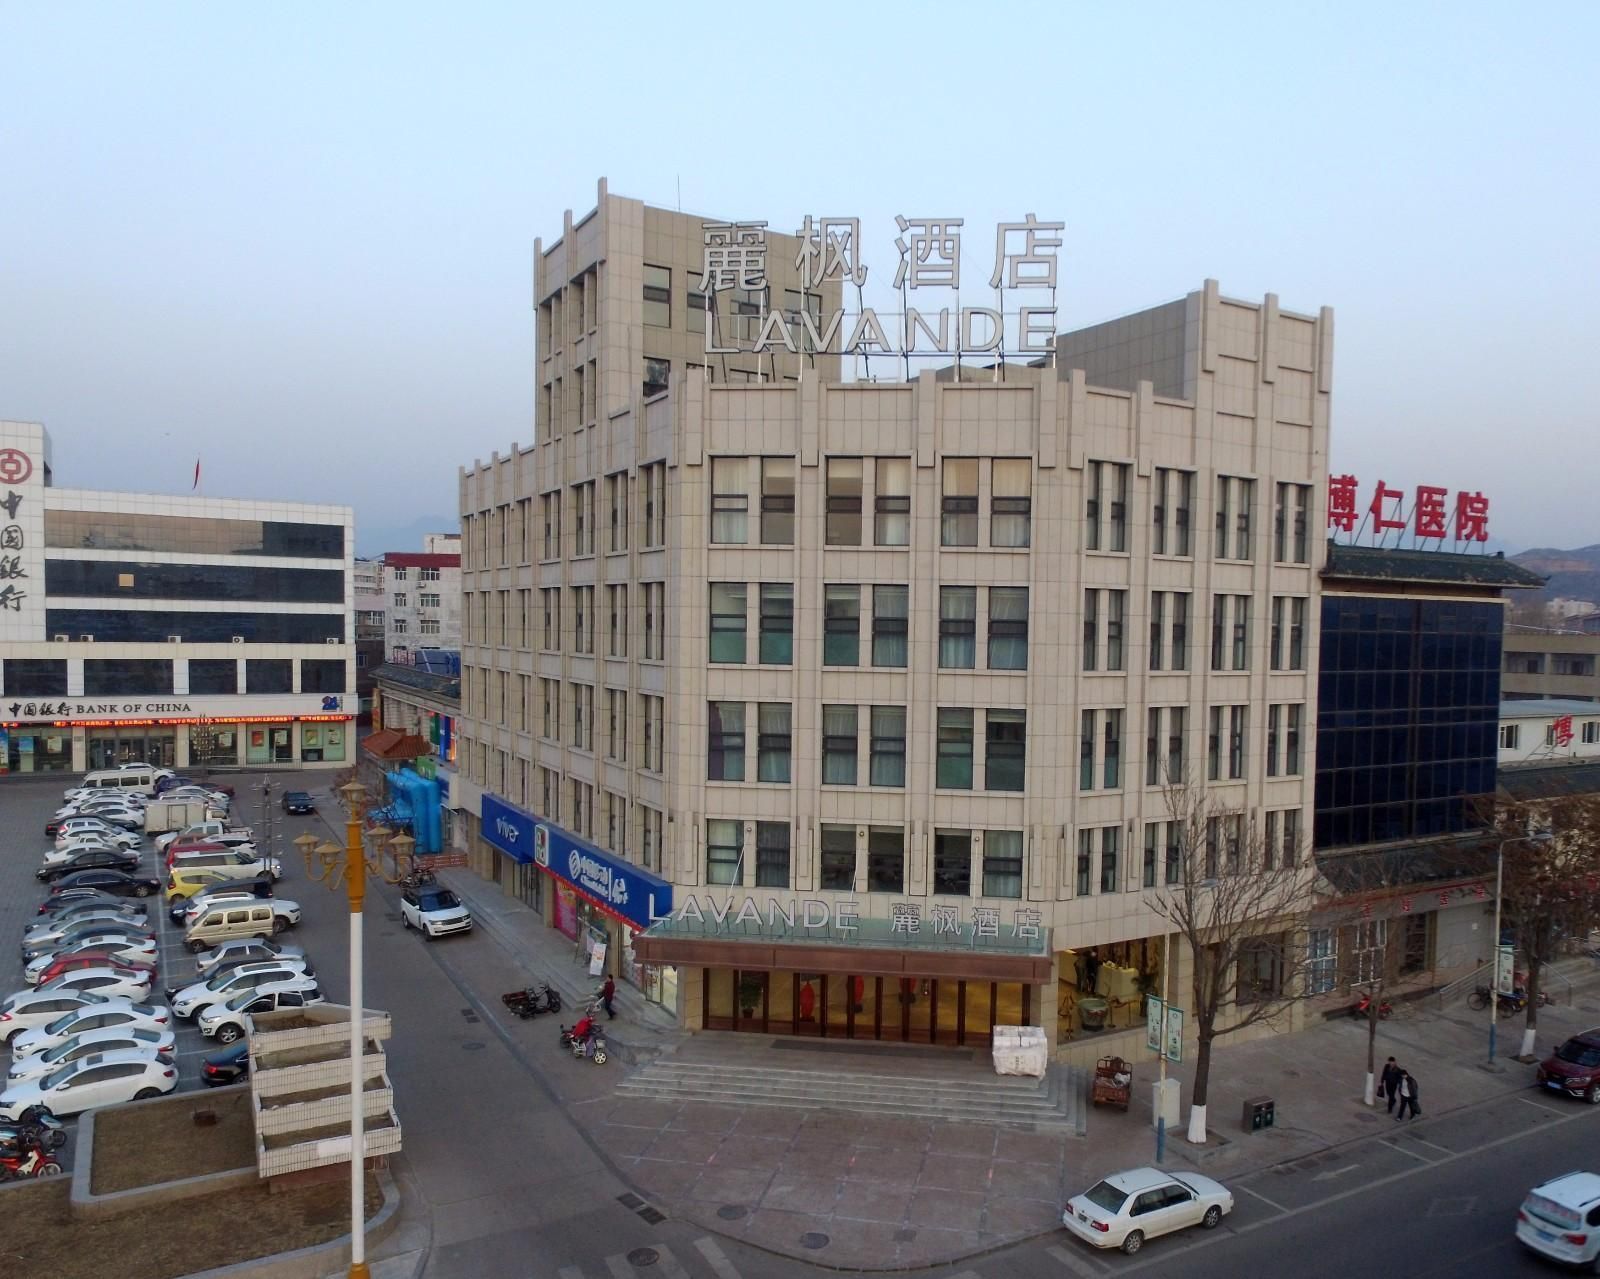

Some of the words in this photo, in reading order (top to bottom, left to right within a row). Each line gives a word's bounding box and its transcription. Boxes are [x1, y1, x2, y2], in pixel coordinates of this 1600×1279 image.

[703, 307, 1058, 353] LAVANDE
[1328, 473, 1489, 542] 博仁医院
[76, 704, 118, 714] BANK
[123, 703, 142, 713] OF
[146, 703, 192, 713] CHINA
[647, 893, 860, 931] LAVANDE
